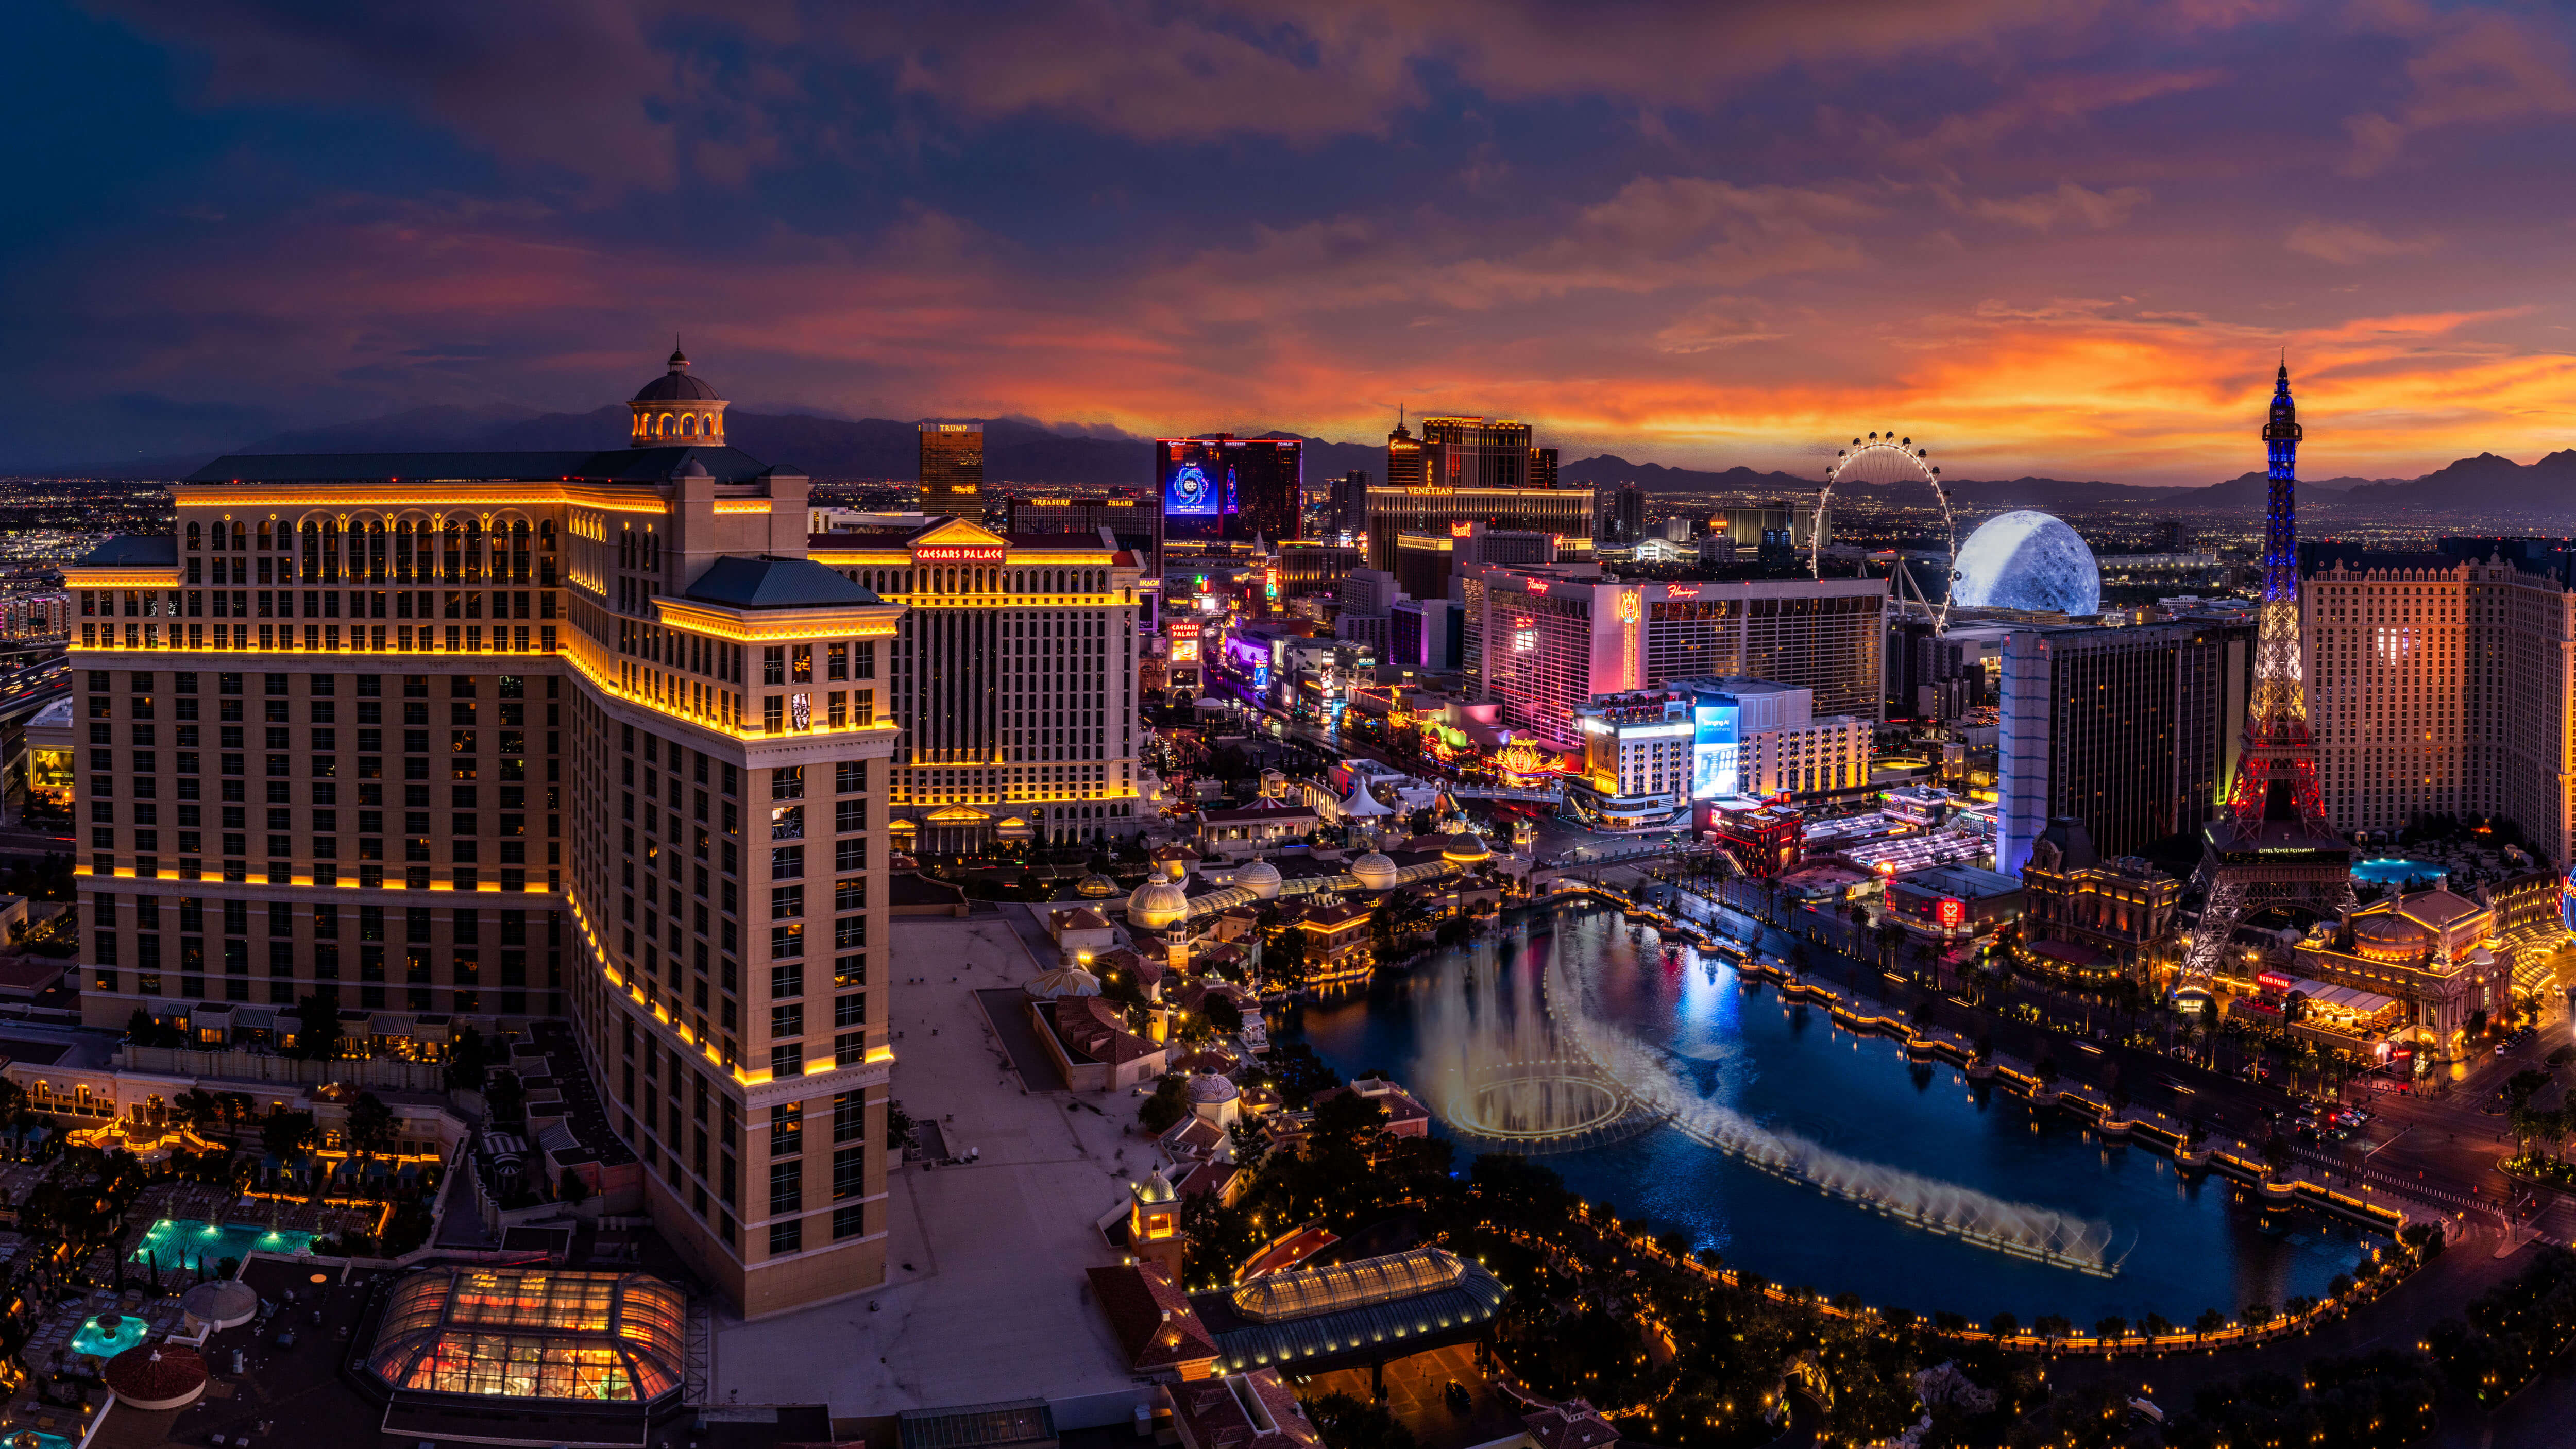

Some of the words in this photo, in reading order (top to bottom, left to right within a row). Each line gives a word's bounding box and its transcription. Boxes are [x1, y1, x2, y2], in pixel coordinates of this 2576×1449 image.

[1391, 439, 1420, 450] Encore
[1407, 487, 1453, 495] VENETIAN
[1452, 522, 1471, 537] Harrah's
[917, 550, 960, 558] CAESARS
[964, 550, 1003, 558] PALACE
[1527, 577, 1549, 594] Flamingo
[1667, 584, 1699, 598] Flamingo
[1510, 734, 1539, 747] Flamingo
[1960, 811, 1984, 821] wahlburgers
[2259, 975, 2273, 984] BEER
[2274, 979, 2289, 987] PARK
